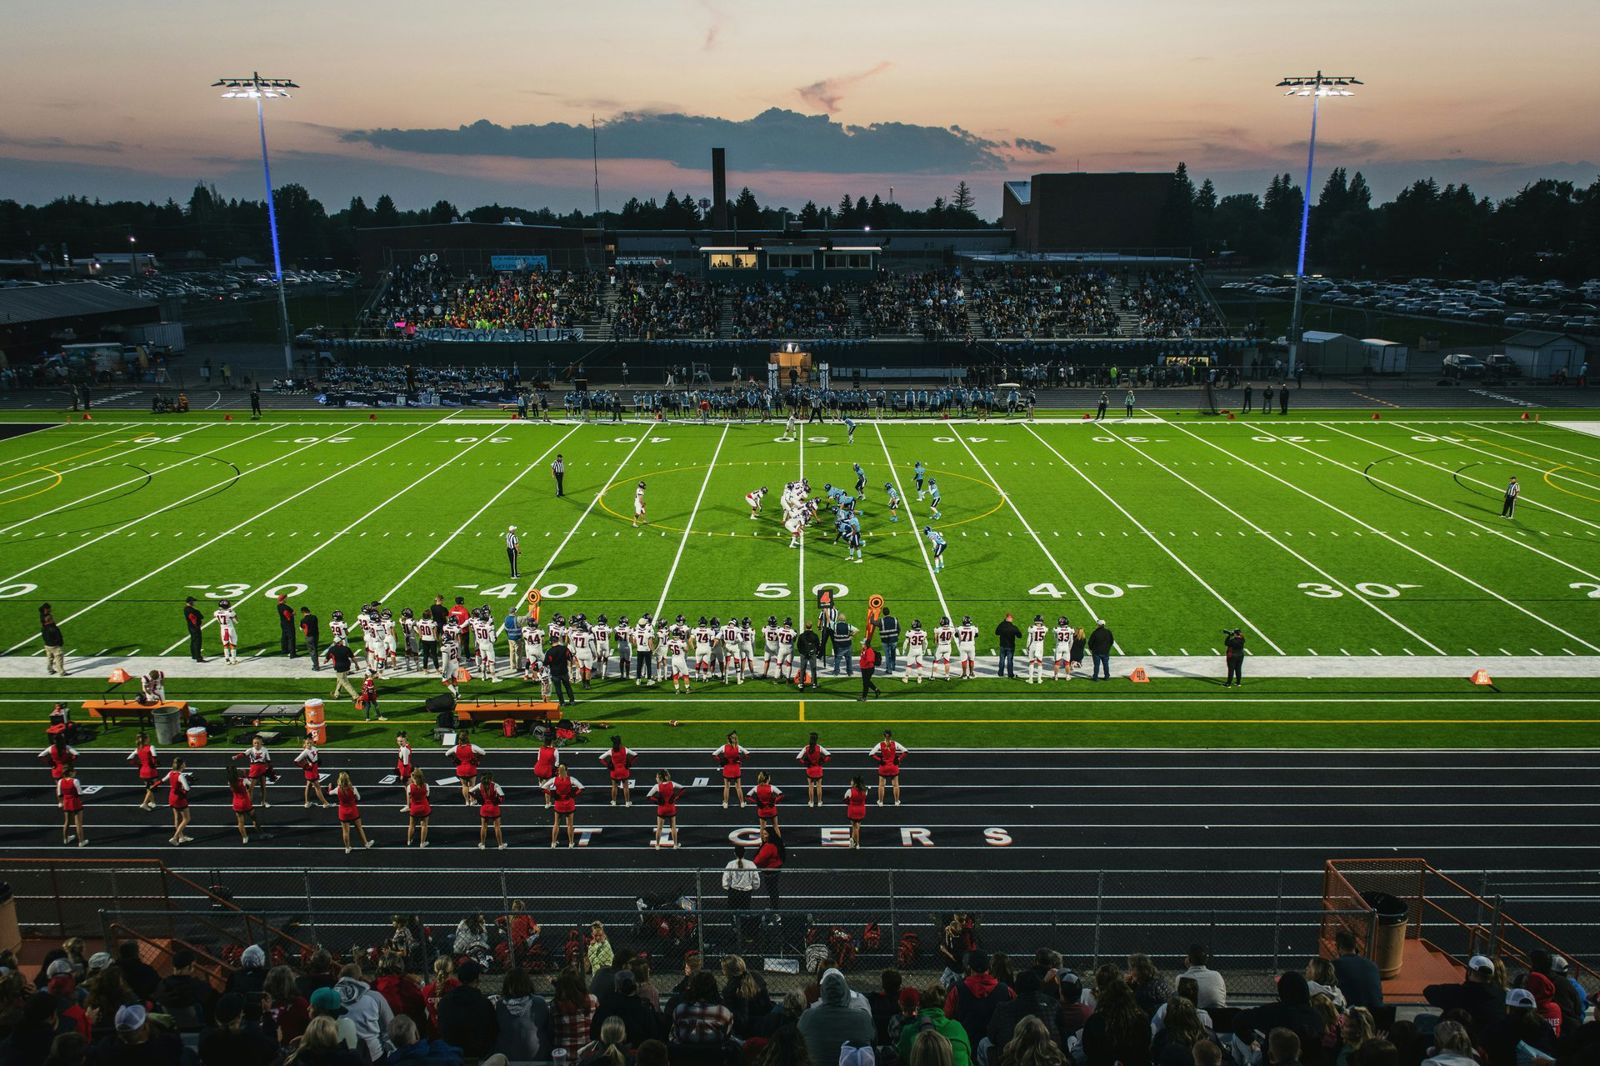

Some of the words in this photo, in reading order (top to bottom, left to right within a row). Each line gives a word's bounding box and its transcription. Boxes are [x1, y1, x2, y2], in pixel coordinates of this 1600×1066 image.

[478, 583, 578, 598] 40
[1028, 583, 1123, 598] 40
[1298, 583, 1401, 598] 30
[820, 591, 831, 603] 4
[217, 615, 227, 625] 17
[476, 629, 488, 639] 50
[528, 634, 540, 645] 44
[596, 631, 606, 641] 19
[697, 633, 708, 644] 74
[725, 630, 735, 641] 10
[779, 633, 792, 644] 79
[940, 631, 952, 641] 40
[961, 631, 972, 642] 71
[1034, 631, 1045, 641] 15
[1058, 632, 1070, 642] 33
[573, 637, 585, 648] 77
[638, 635, 644, 646] 7
[911, 636, 924, 646] 35
[669, 644, 680, 655] 56
[574, 827, 1013, 848] TIGERS
